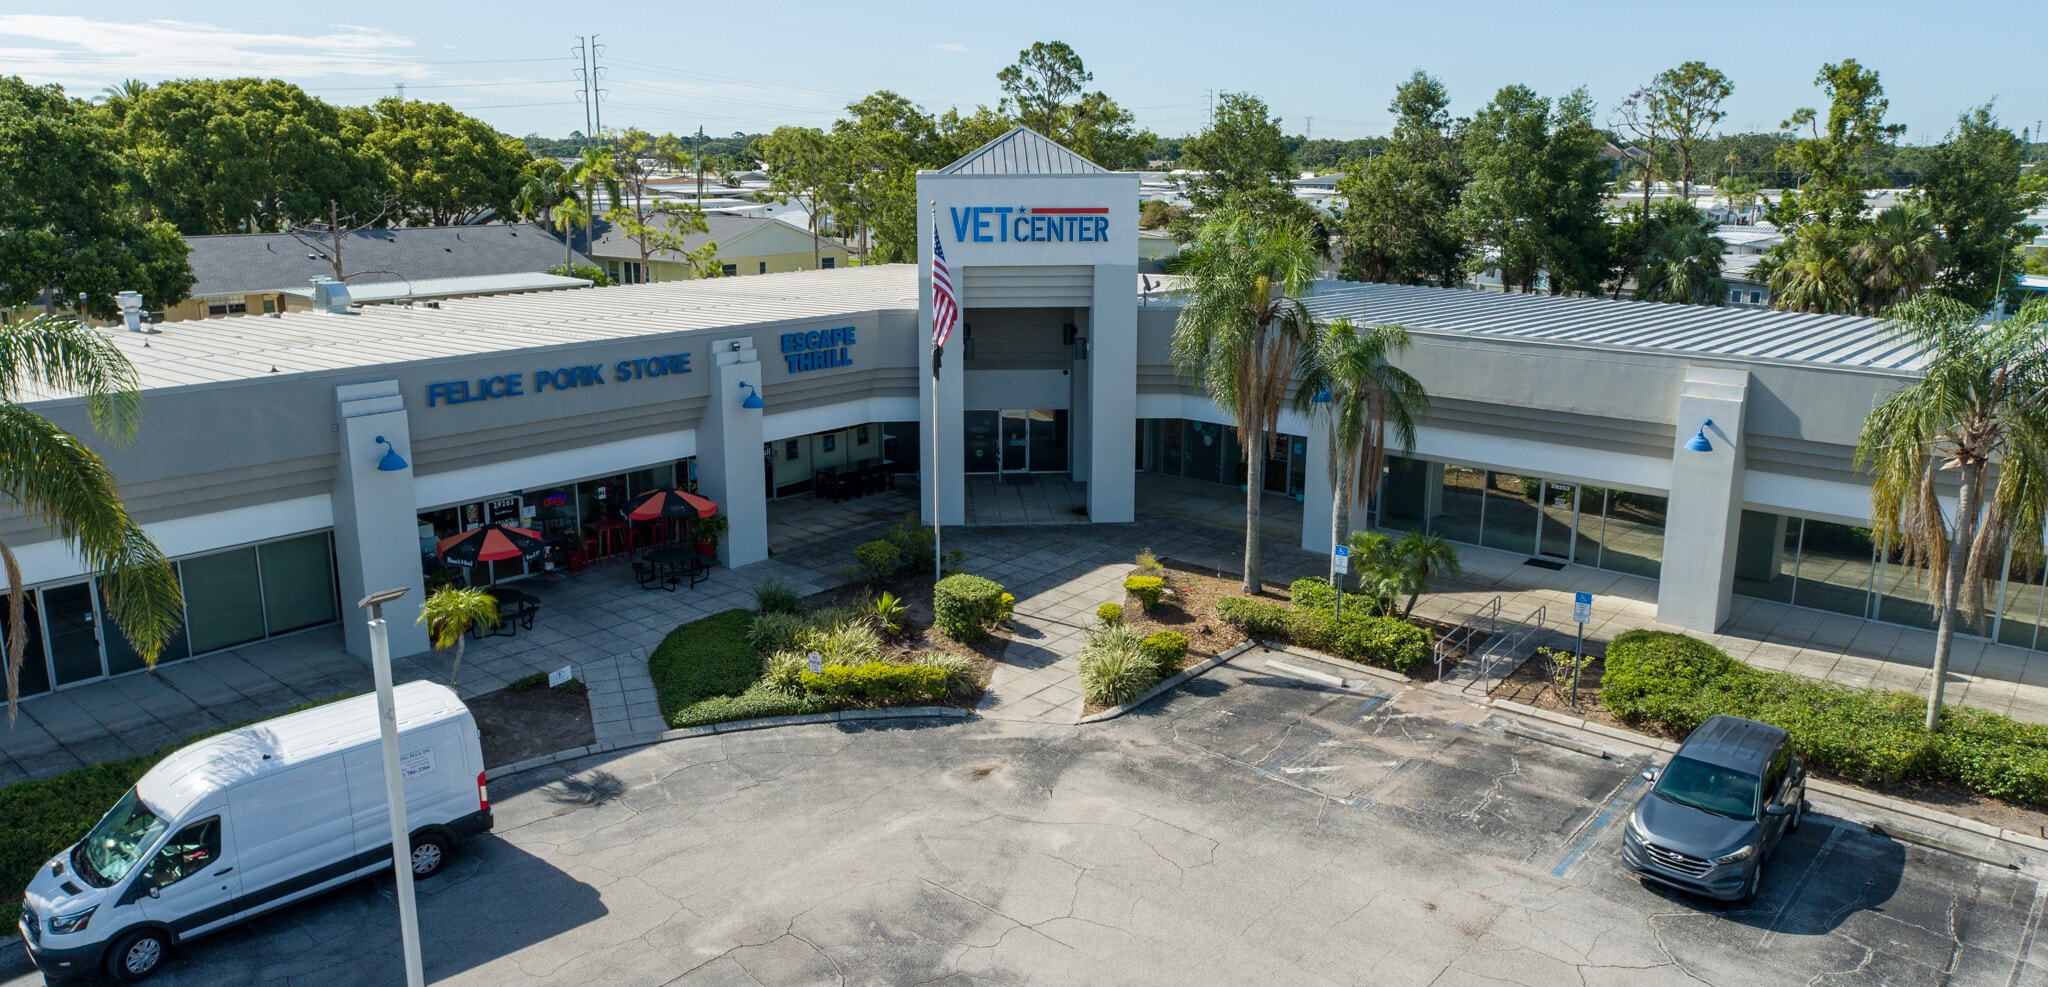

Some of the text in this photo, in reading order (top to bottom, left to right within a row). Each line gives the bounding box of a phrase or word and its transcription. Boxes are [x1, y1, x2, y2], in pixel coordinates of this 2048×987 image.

[950, 206, 1109, 243] VET CENTER
[781, 326, 856, 354] ESCAPE
[785, 347, 853, 374] THRILL
[428, 352, 692, 407] FELICE PORK STORE
[493, 498, 515, 509] 29263
